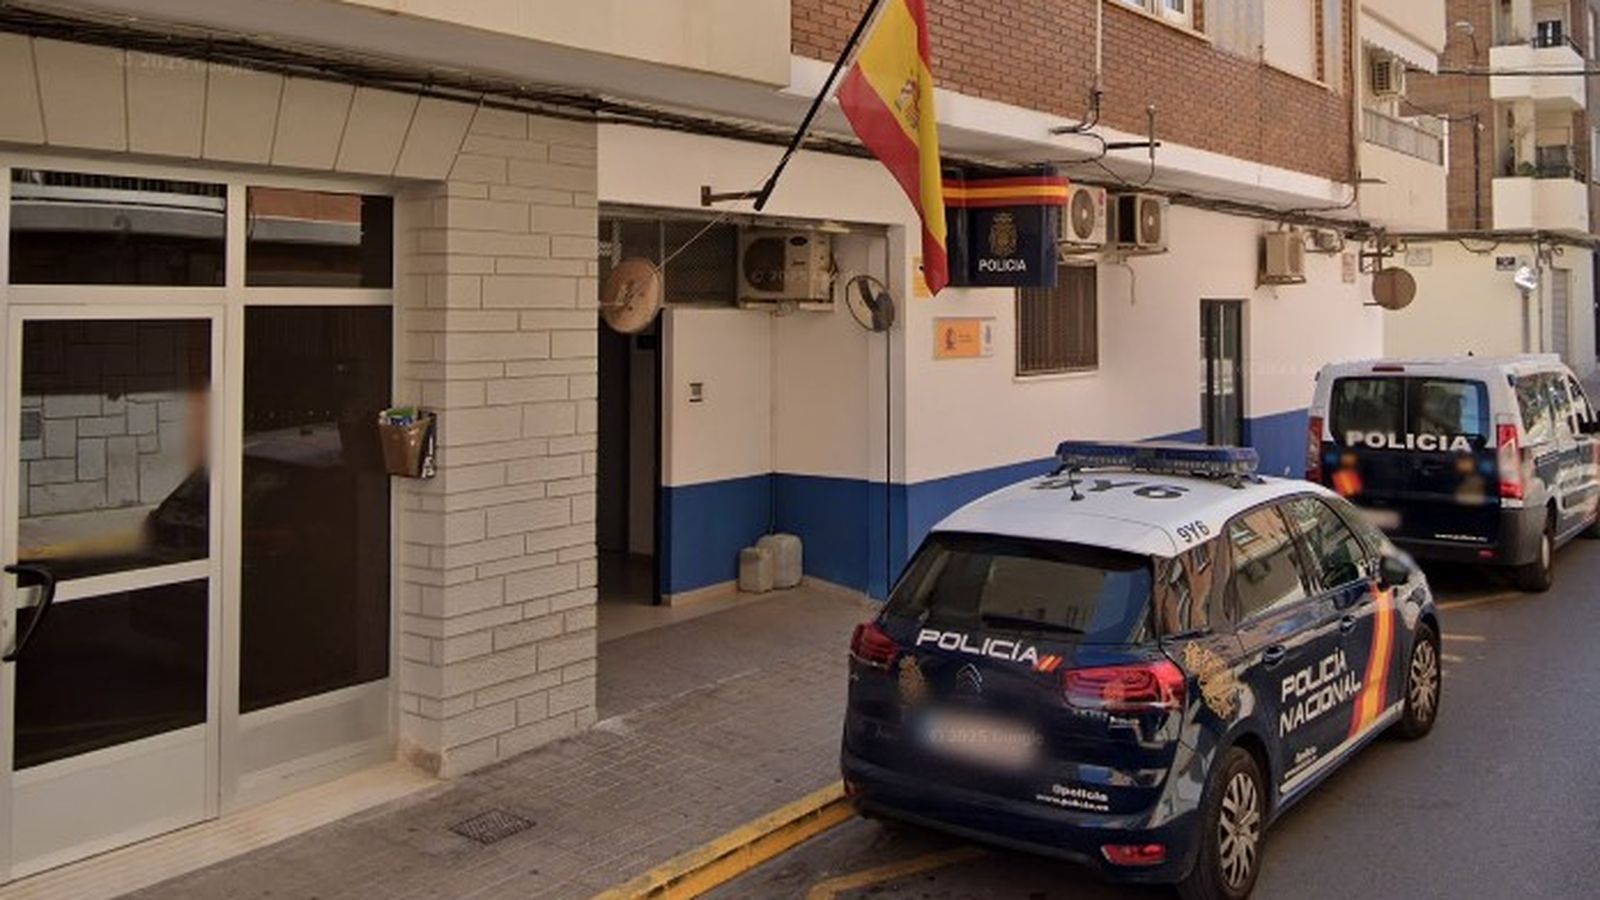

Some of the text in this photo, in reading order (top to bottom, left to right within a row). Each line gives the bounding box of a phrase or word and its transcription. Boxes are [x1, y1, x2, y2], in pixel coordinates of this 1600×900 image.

[978, 259, 1027, 272] POLICIA
[1346, 430, 1472, 452] POLICIA
[1177, 520, 1211, 543] 9Y6
[916, 629, 1040, 667] POLICÍA
[1281, 647, 1347, 702] POLICÍA
[1279, 670, 1362, 738] NACIONAL
